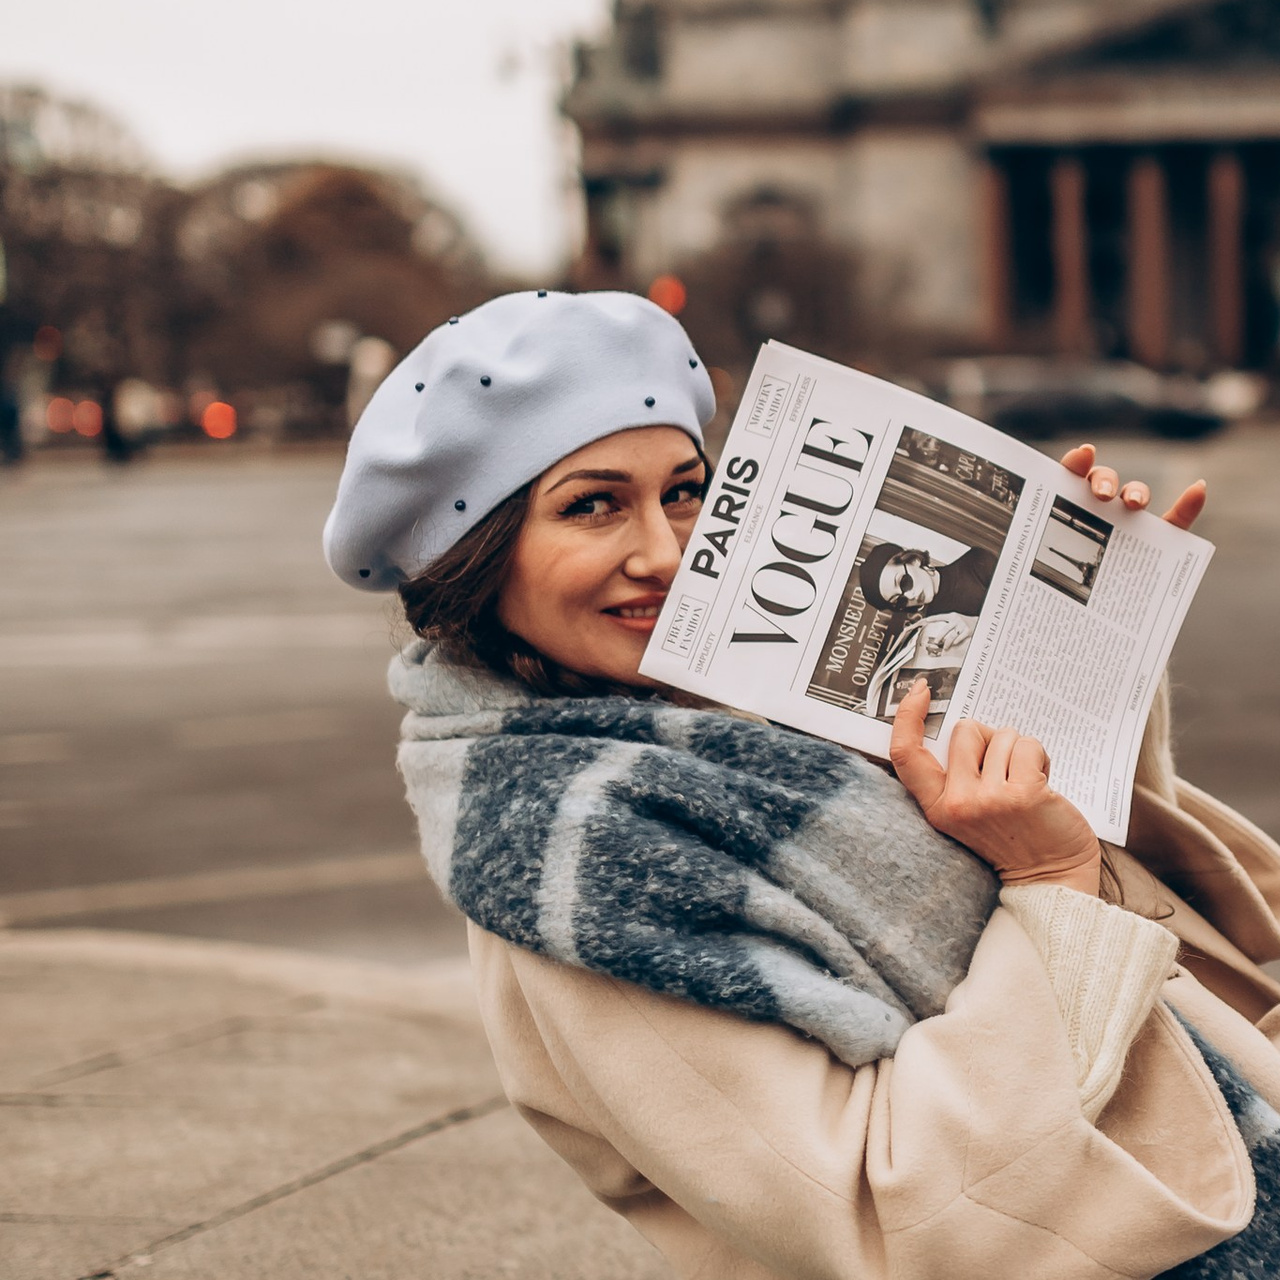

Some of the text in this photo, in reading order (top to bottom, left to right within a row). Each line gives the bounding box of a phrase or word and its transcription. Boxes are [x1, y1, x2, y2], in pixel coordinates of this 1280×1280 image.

[749, 382, 773, 425] MODERN
[762, 386, 785, 430] FASHION
[789, 376, 811, 422] EFFORTLESS
[690, 457, 759, 579] PARIS
[726, 416, 876, 648] VOGUE
[744, 503, 763, 543] ELEGANCE
[1013, 524, 1031, 561] PARISIAN
[1005, 561, 1018, 583] WITH
[1171, 551, 1193, 597] CONFIDENCE
[993, 610, 1002, 619] IN
[997, 587, 1010, 608] LOVE
[667, 602, 689, 644] FRENCH
[679, 606, 703, 650] FASHION
[986, 622, 998, 642] FALL
[694, 631, 716, 674] SIMPLICITY
[851, 610, 892, 686] OMELETT
[1129, 673, 1147, 711] ROMANTIC
[1108, 778, 1120, 825] INDIVIDUALITY
